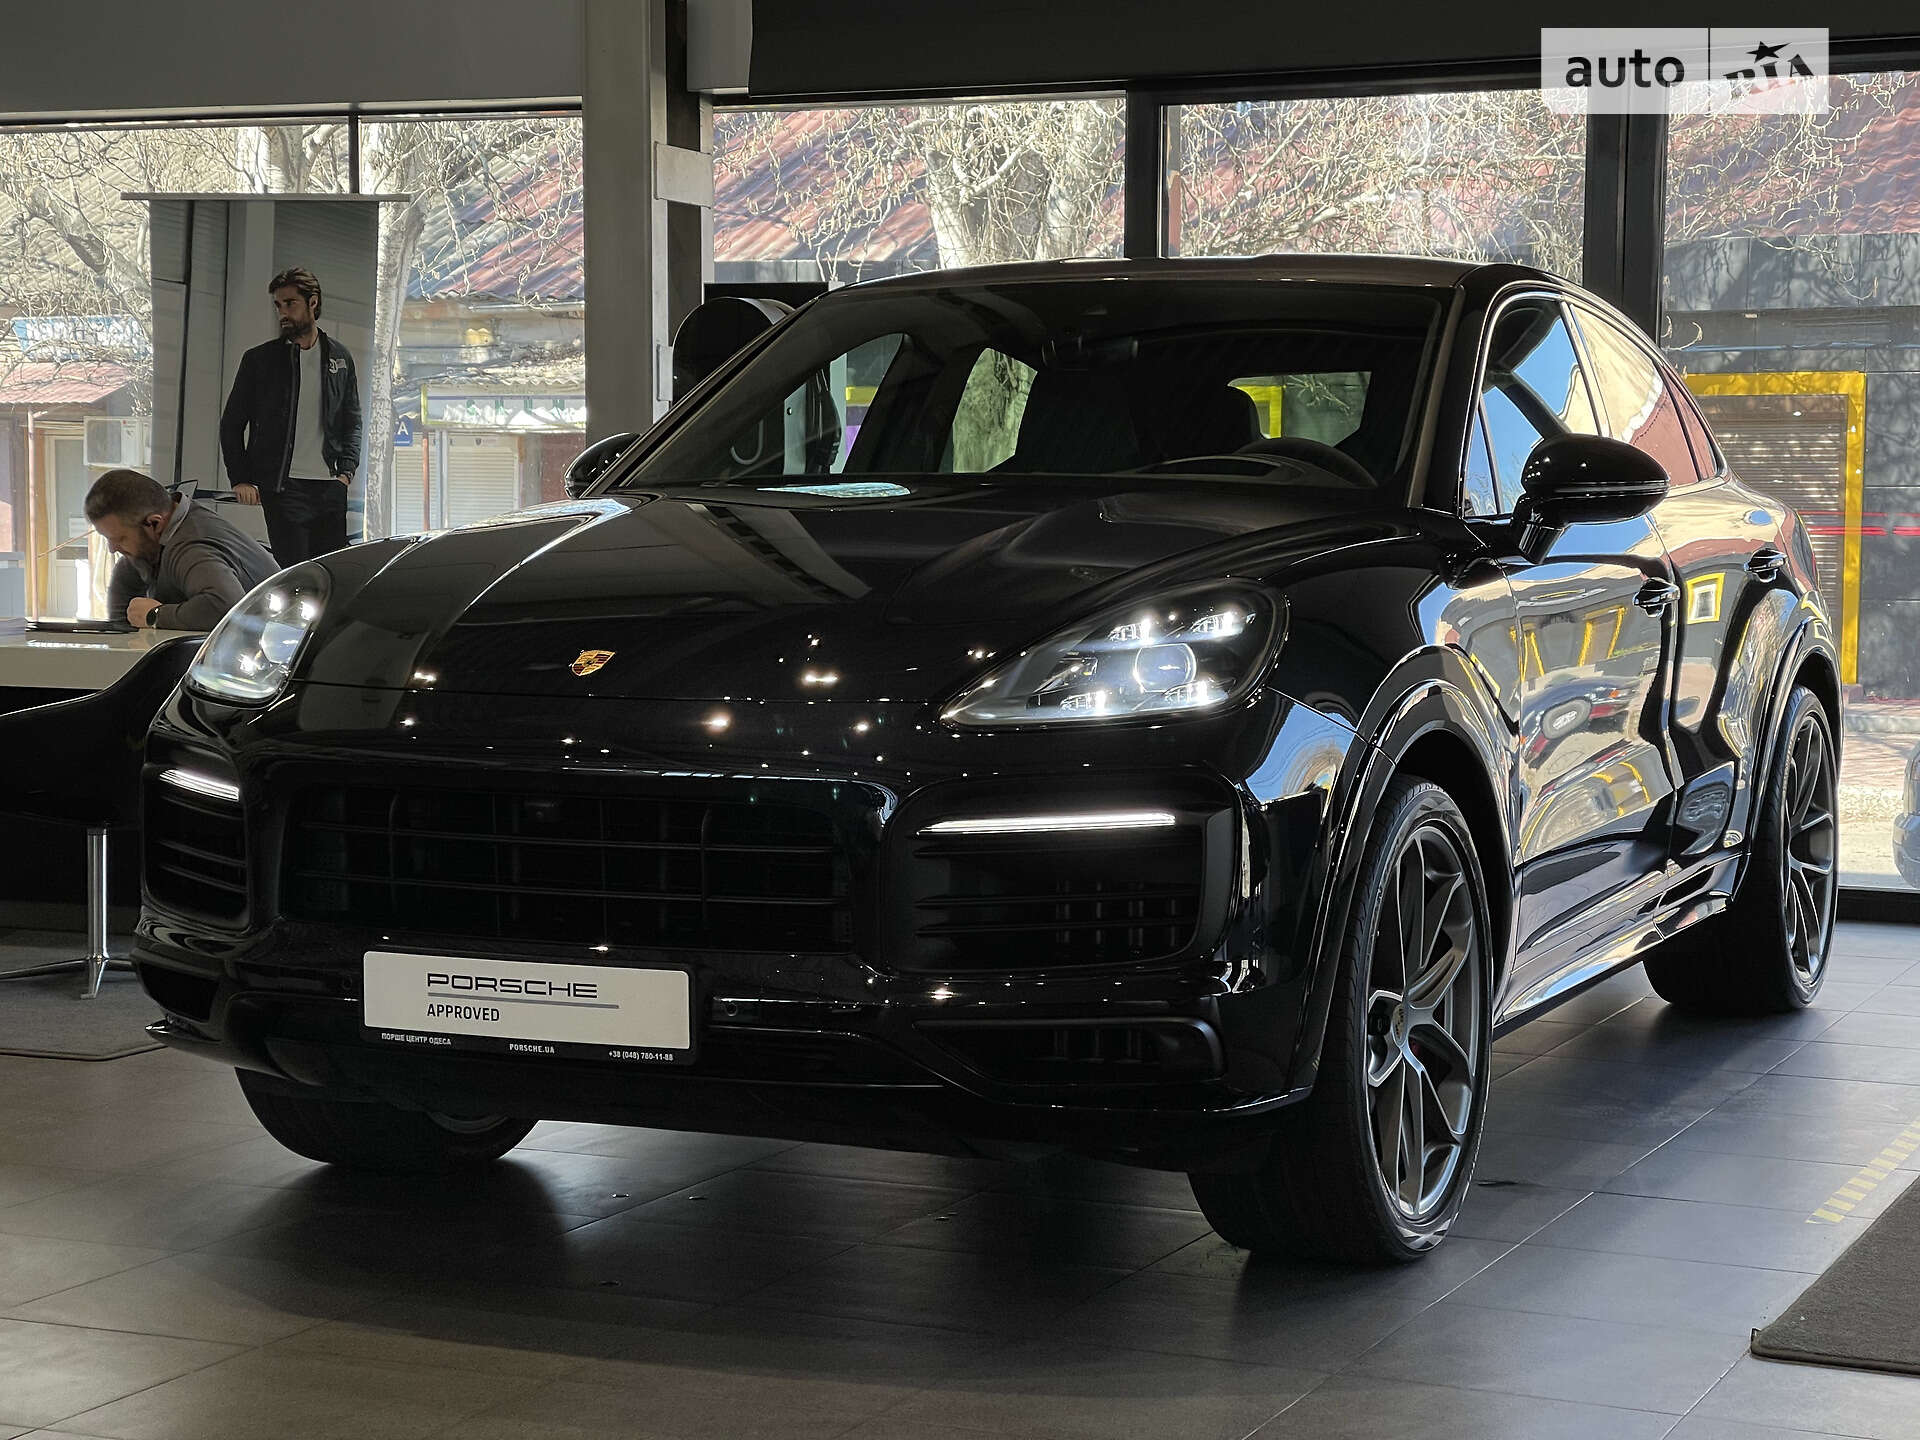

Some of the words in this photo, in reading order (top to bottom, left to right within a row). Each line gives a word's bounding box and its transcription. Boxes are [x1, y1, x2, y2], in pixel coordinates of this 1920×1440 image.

[427, 972, 598, 999] PORSCHE
[427, 1003, 500, 1022] APPROVED
[381, 1032, 405, 1042] ПОРШЕ
[405, 1034, 428, 1044] ЦЕНТР
[428, 1036, 452, 1046] ОДЕСА
[509, 1043, 555, 1054] PORSCHE.UA
